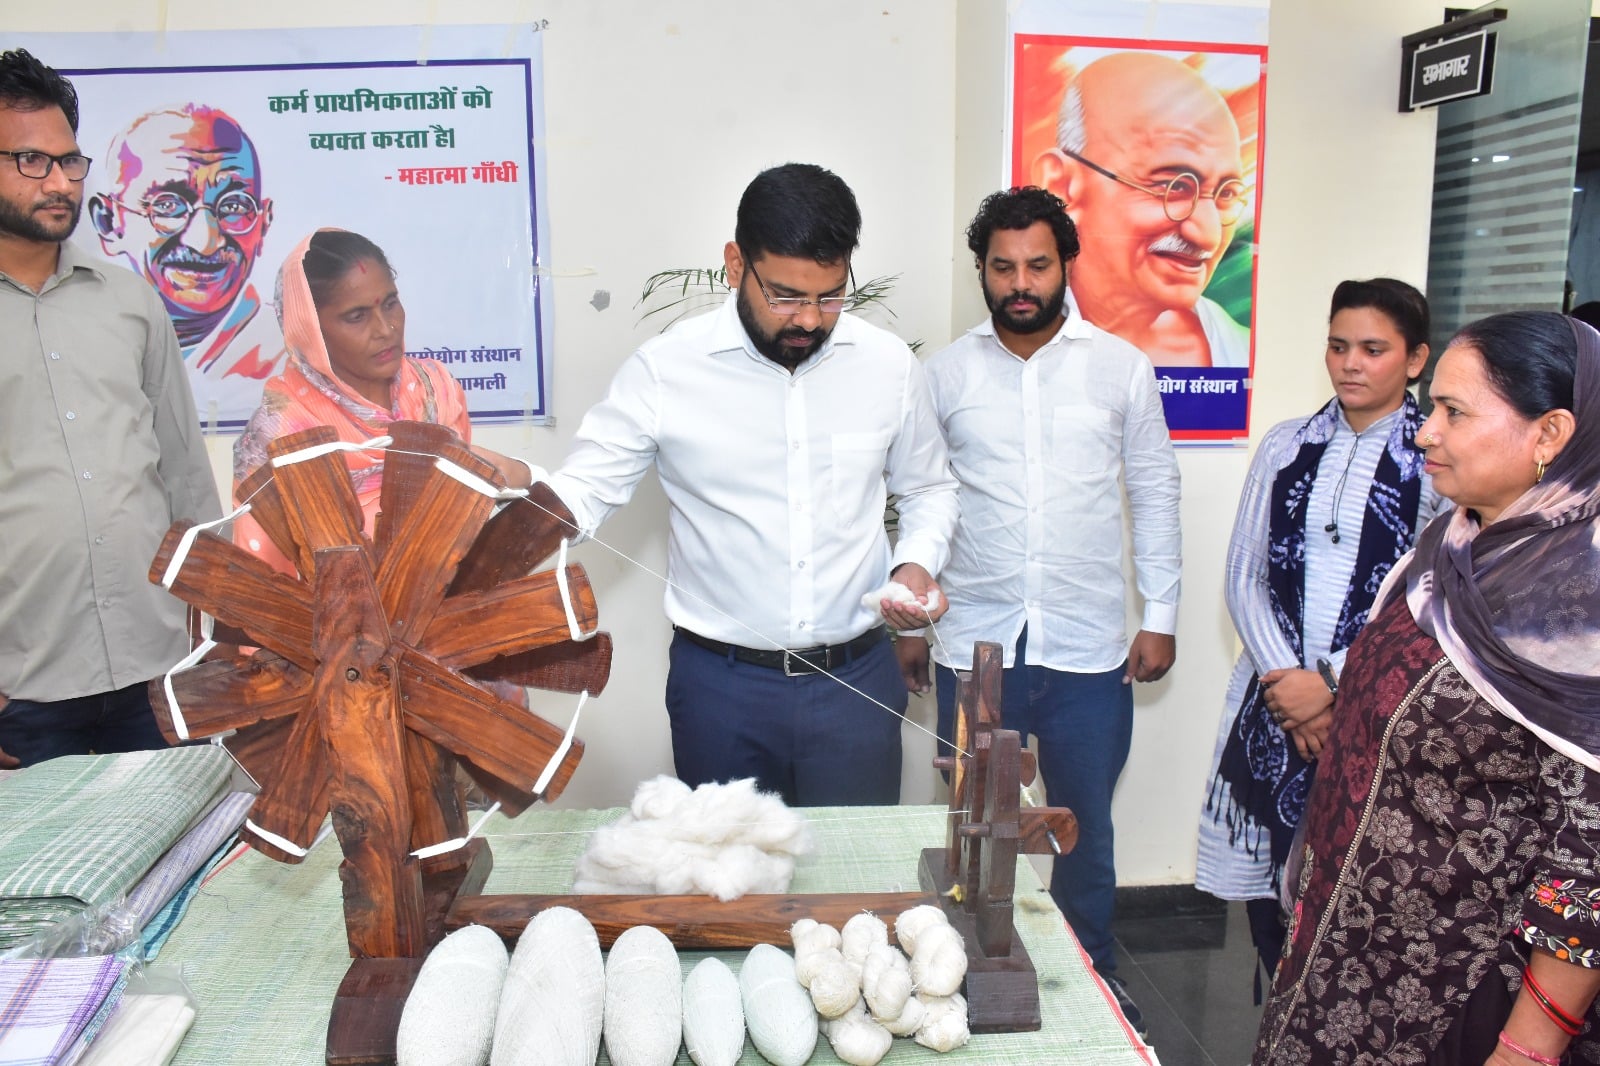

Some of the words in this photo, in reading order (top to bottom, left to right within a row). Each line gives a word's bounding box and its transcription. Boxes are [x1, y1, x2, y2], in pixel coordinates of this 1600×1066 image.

[1422, 54, 1471, 85] सभागार
[268, 89, 309, 114] कर्म
[314, 86, 459, 113] प्राथमिकताओं
[462, 85, 493, 109] को
[309, 131, 367, 151] व्यक्त
[371, 130, 430, 149] करता
[397, 166, 468, 185] महात्मा
[470, 345, 522, 363] संस्थान
[1189, 376, 1239, 394] संस्थान
